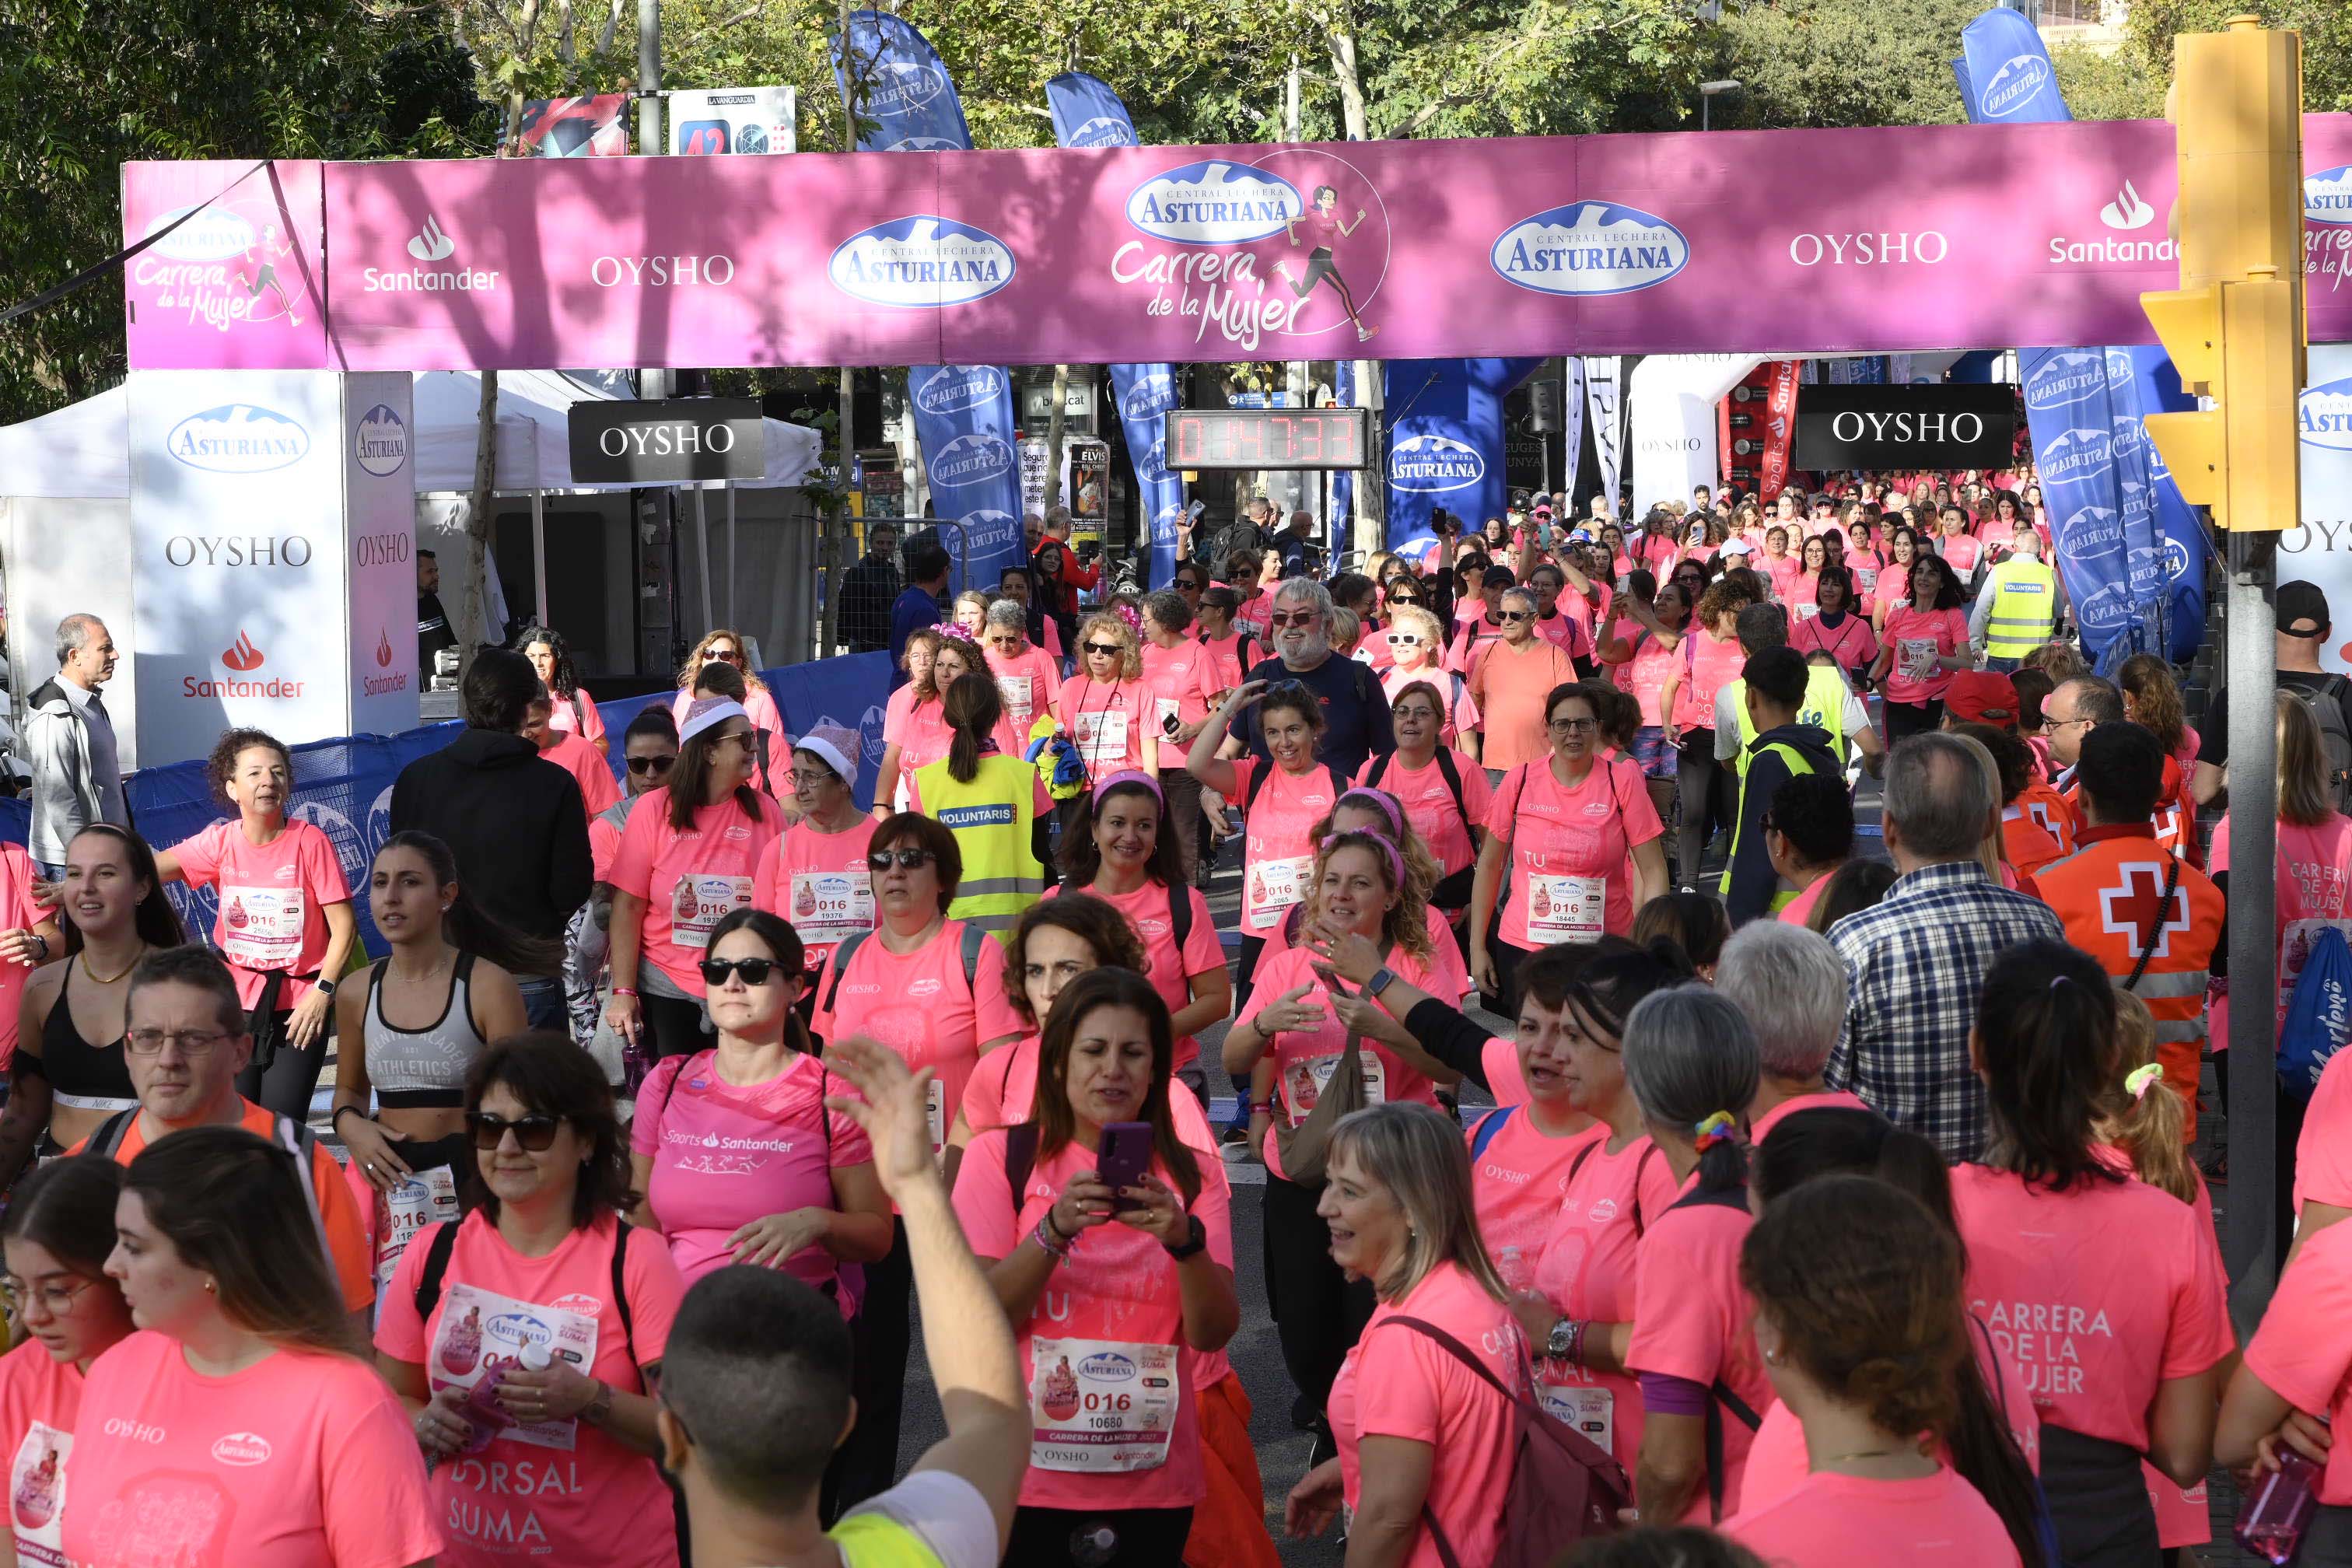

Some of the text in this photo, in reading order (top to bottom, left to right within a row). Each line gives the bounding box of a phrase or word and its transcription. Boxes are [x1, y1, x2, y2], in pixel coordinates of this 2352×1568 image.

[715, 96, 754, 104] VANGUARDIA
[1166, 187, 1283, 198] CENTRAL LECHERA
[1140, 192, 1288, 224] ASTURIANA
[1537, 232, 1668, 244] CENTRAL LECHERA
[871, 247, 929, 256] CENTRAL
[1507, 237, 1673, 272] ASTURIANA
[1790, 231, 1947, 266] OYSHO
[2049, 236, 2179, 263] Santand
[845, 247, 999, 282] ASTURIANA
[1111, 240, 1255, 283] Carrera
[2322, 253, 2336, 274] la
[135, 260, 226, 286] Carrera
[591, 255, 733, 286] OYSHO
[364, 268, 499, 292] Santander
[158, 281, 260, 331] de la Mujer
[1147, 279, 1311, 352] de la Mujer
[1832, 411, 1983, 443] OYSHO
[180, 430, 299, 456] ASTURIANA
[359, 429, 404, 460] ASTURIANA
[600, 424, 734, 457] OYSHO
[1179, 418, 1353, 460] 01:47:33
[1642, 437, 1700, 454] OYSHO
[1082, 452, 1104, 460] ELVIS
[1391, 460, 1476, 479] ASTURIANA
[1765, 442, 1784, 493] Sports
[165, 536, 312, 567] OYSHO
[357, 532, 408, 567] OYSHO
[2004, 583, 2042, 592] VOLUNTARIS
[184, 677, 305, 698] Santander
[364, 672, 407, 696] Santander
[1697, 690, 1708, 699] TU
[905, 751, 919, 764] TU
[940, 806, 1010, 824] VOLUNTARIS
[1528, 803, 1559, 813] OYSHO
[670, 832, 702, 842] OYSHO
[1248, 836, 1263, 852] TU
[1524, 850, 1545, 868] TU
[700, 887, 730, 895] ASTURIANA
[1269, 884, 1292, 895] 016
[2302, 880, 2321, 894] DE
[701, 904, 728, 915] 016
[819, 900, 846, 910] 016
[1553, 903, 1579, 913] 016
[251, 915, 275, 926] 016
[680, 933, 703, 942] OYSHO
[377, 1060, 451, 1076] ATHLETICS
[92, 1099, 113, 1108] NIKE
[664, 1129, 793, 1153] Sports Santander
[394, 1211, 426, 1228] 016
[492, 1321, 546, 1344] ASTURIANA
[558, 1329, 587, 1344] SUMA
[1993, 1331, 2078, 1363] DE LA
[1083, 1363, 1132, 1377] ASTURIANA
[1084, 1393, 1131, 1411] 016
[1580, 1404, 1602, 1412] SUMA
[1089, 1416, 1122, 1429] 10680
[1049, 1433, 1089, 1442] CARRERA
[1045, 1450, 1089, 1461] OYSHO
[1122, 1451, 1157, 1461] Santander
[448, 1497, 547, 1544] SUMA
